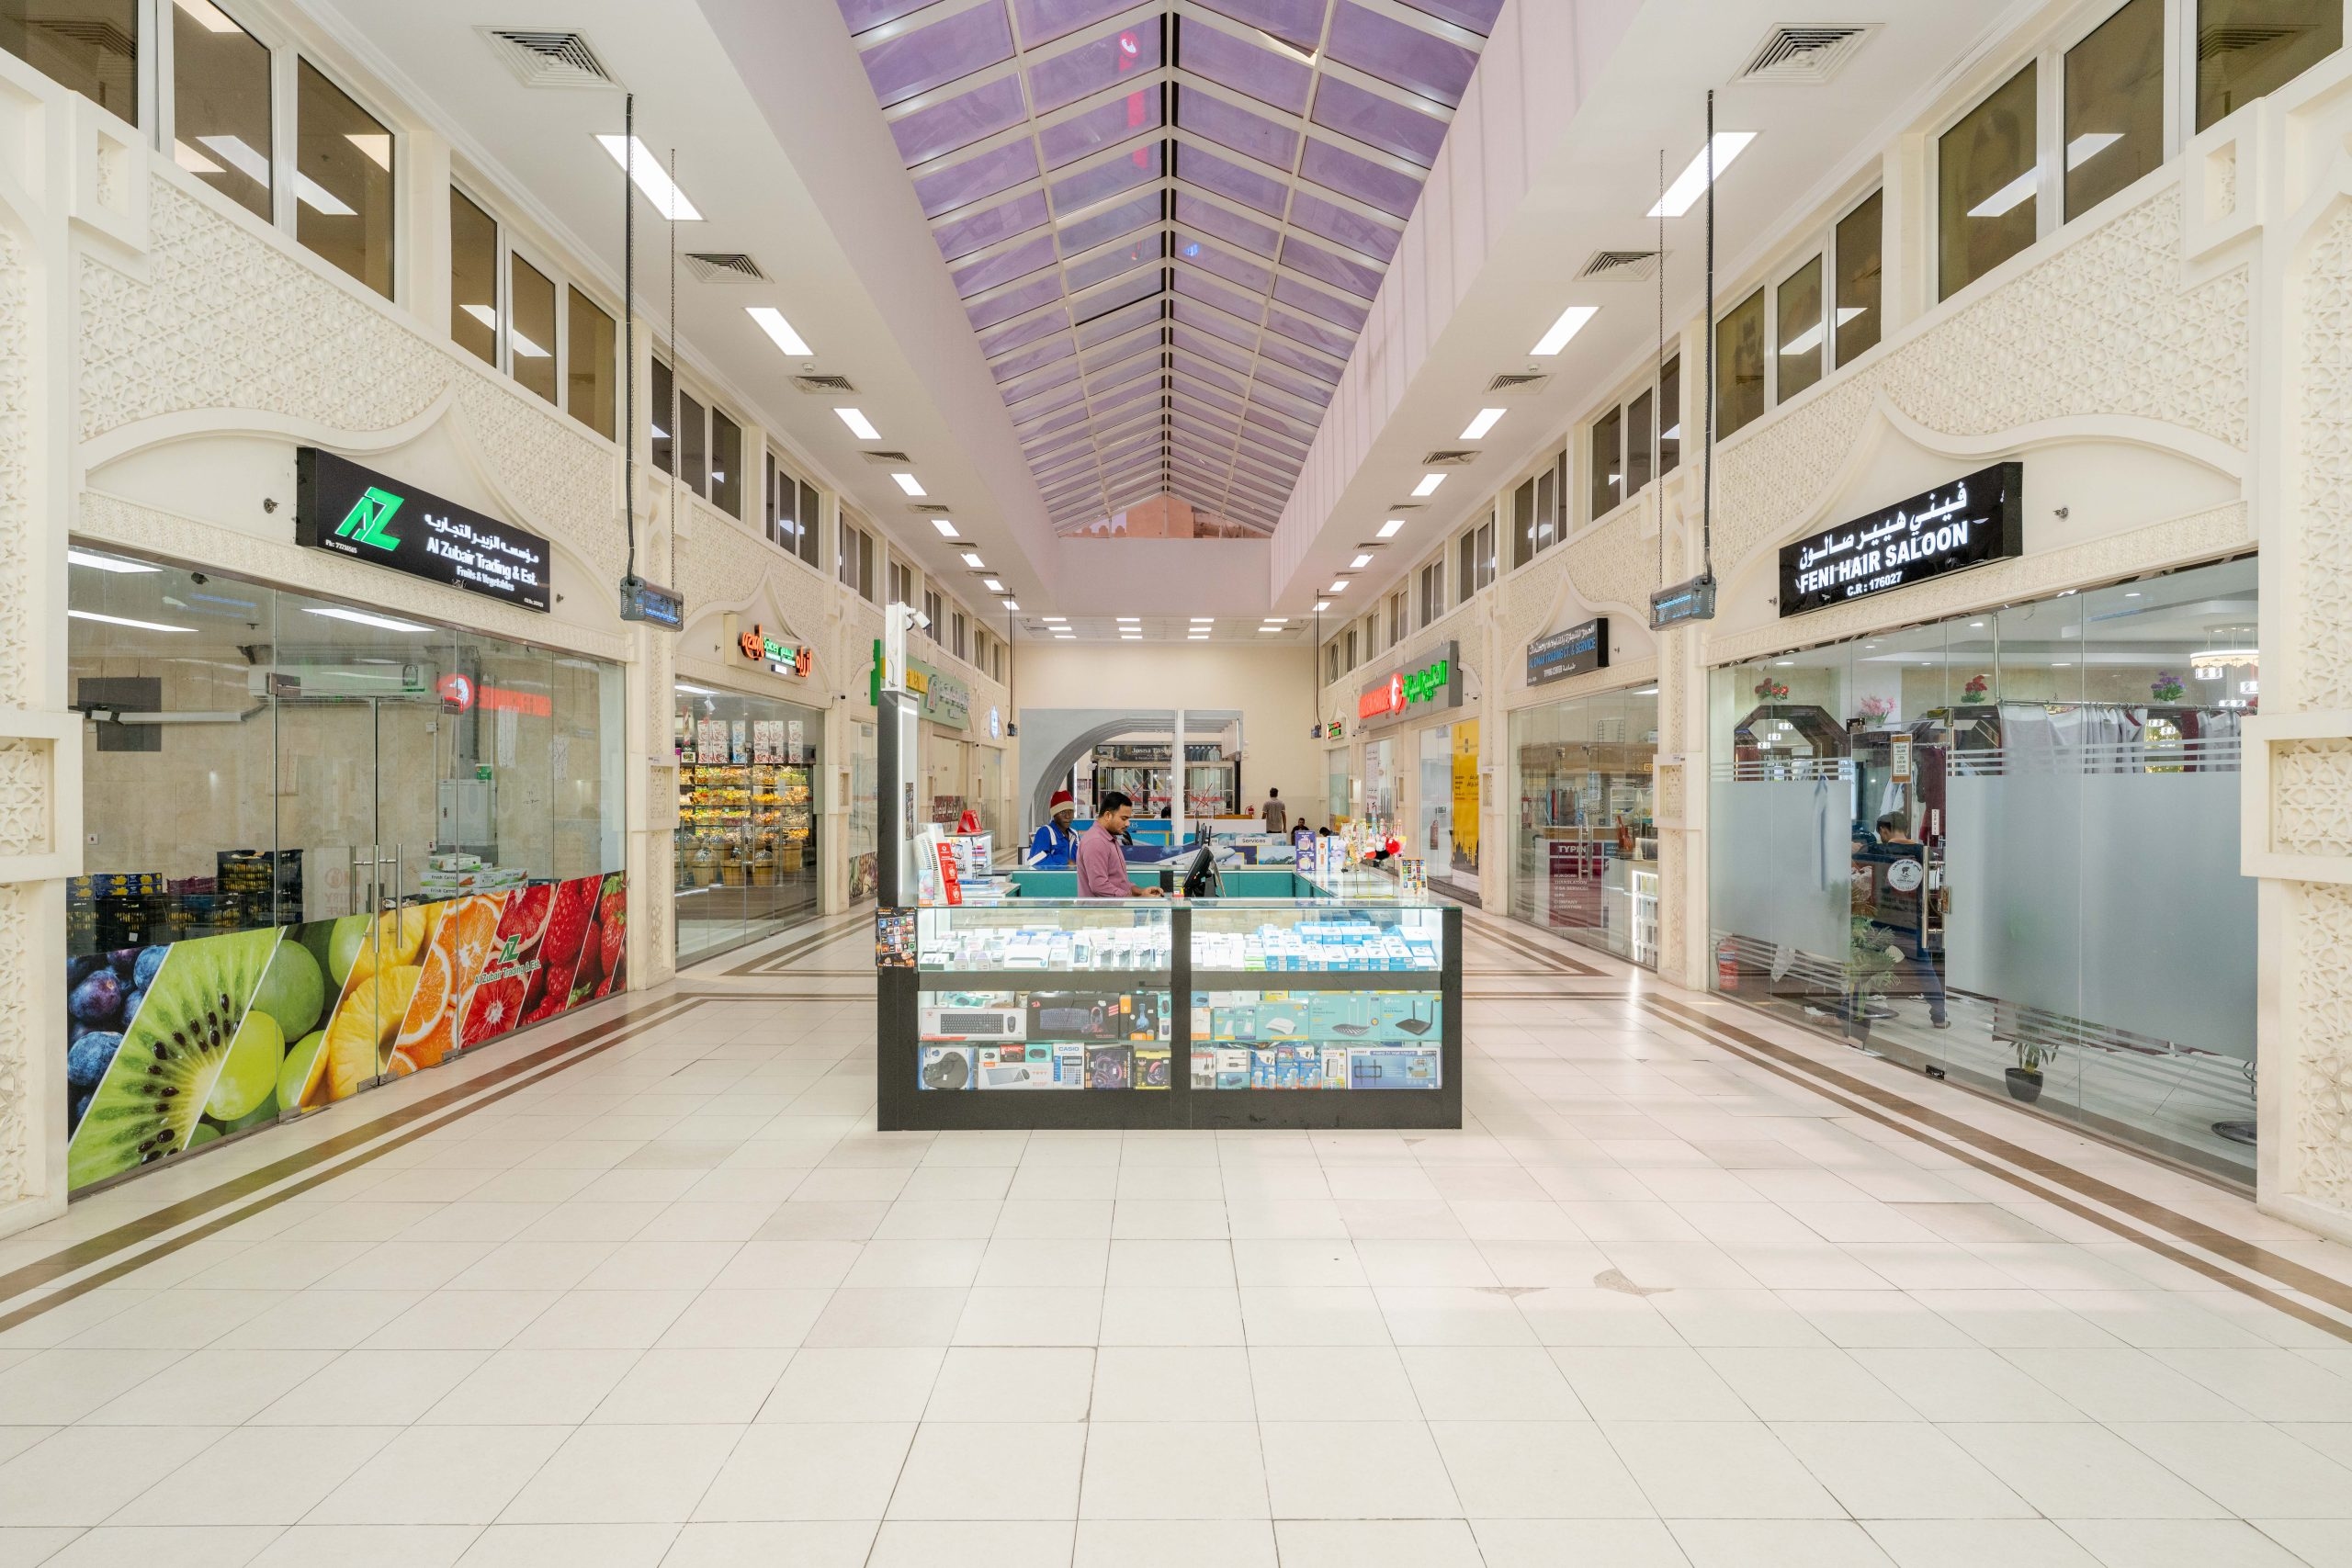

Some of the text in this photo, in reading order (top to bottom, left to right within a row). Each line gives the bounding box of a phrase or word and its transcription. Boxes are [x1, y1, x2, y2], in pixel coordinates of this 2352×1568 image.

[1910, 481, 1967, 536] فيني
[426, 536, 538, 586] Al Zubair Trading & Est.
[1799, 534, 1855, 570] صالون
[1800, 520, 1968, 594] FENI HAIR SALOON
[481, 573, 514, 592] Vegetables
[1869, 571, 1903, 591] 176027
[1558, 845, 1593, 853] TYPIN
[482, 969, 502, 983] Zubair
[503, 964, 525, 978] Trading
